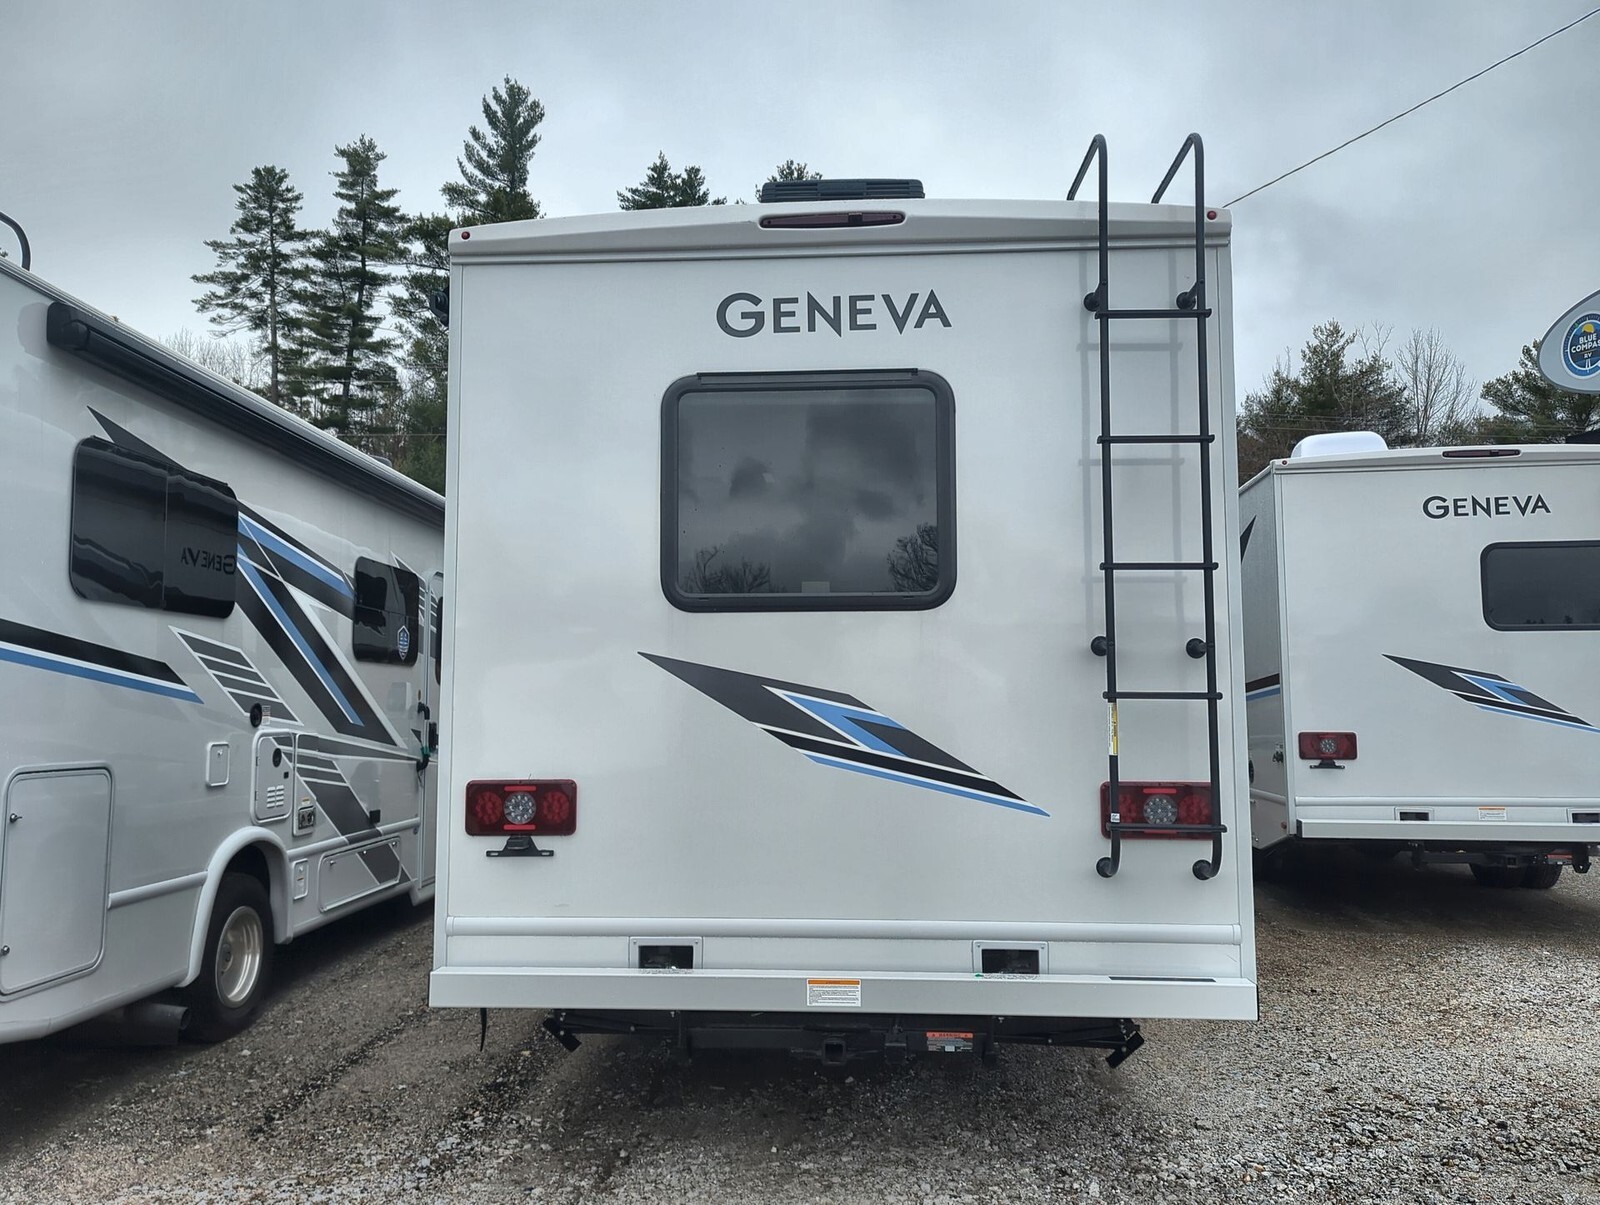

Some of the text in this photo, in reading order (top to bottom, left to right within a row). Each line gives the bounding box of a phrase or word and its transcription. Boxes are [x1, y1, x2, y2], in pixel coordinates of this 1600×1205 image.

[716, 289, 952, 337] GENEVA
[1579, 333, 1597, 344] BLUE
[1423, 494, 1551, 519] GENEVA
